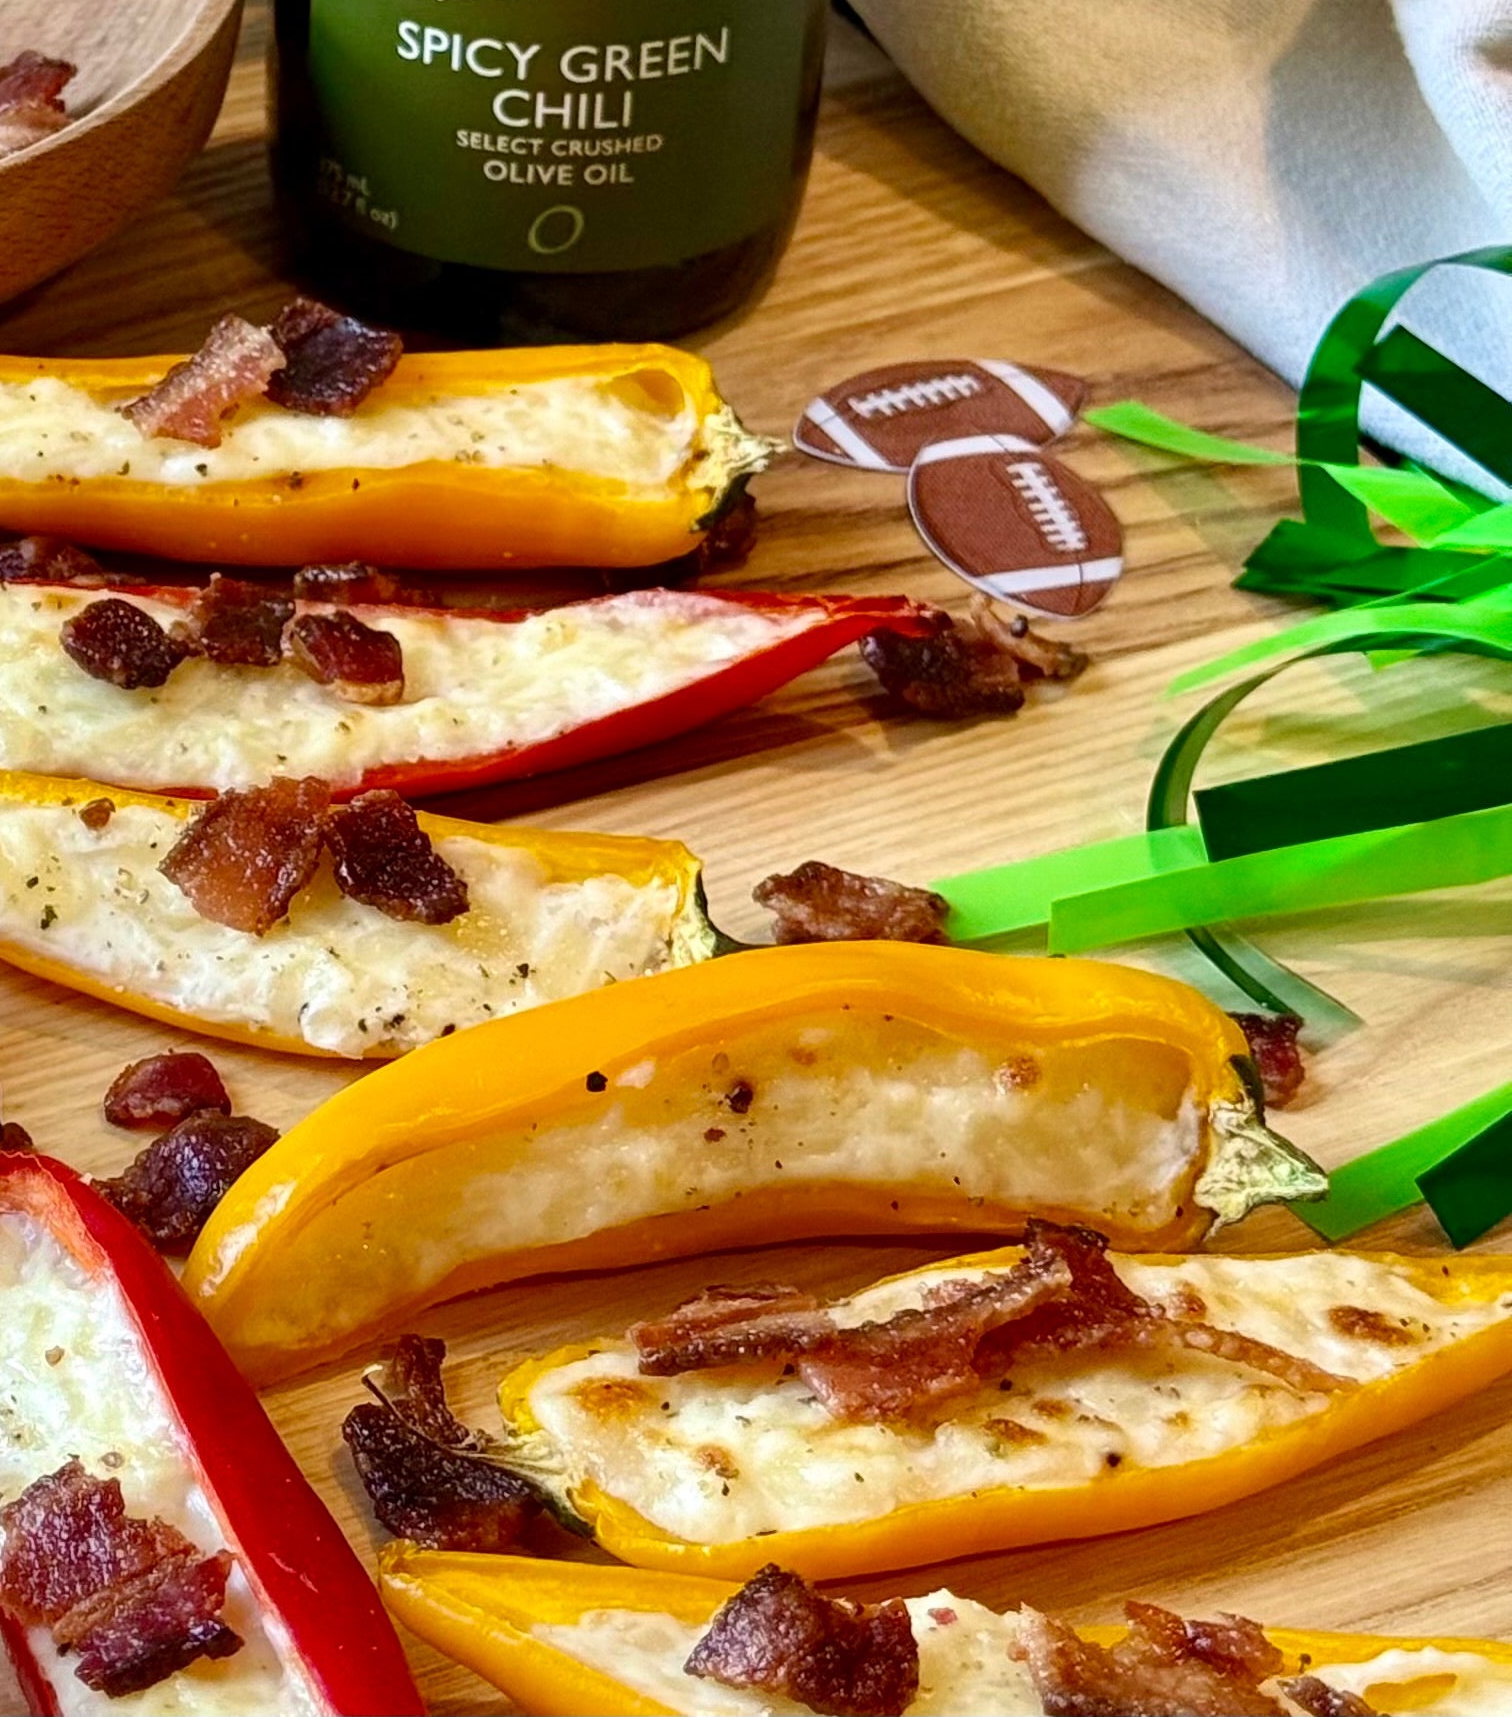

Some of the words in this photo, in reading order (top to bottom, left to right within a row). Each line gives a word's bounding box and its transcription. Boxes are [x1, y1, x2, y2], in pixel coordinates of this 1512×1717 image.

[396, 19, 541, 81] SPICY
[559, 26, 730, 83] GREEN
[491, 88, 633, 130] CHILI
[455, 129, 544, 156] SELECT
[550, 133, 664, 157] CRUSHED
[482, 159, 574, 186] OLIVE
[582, 162, 636, 186] OIL
